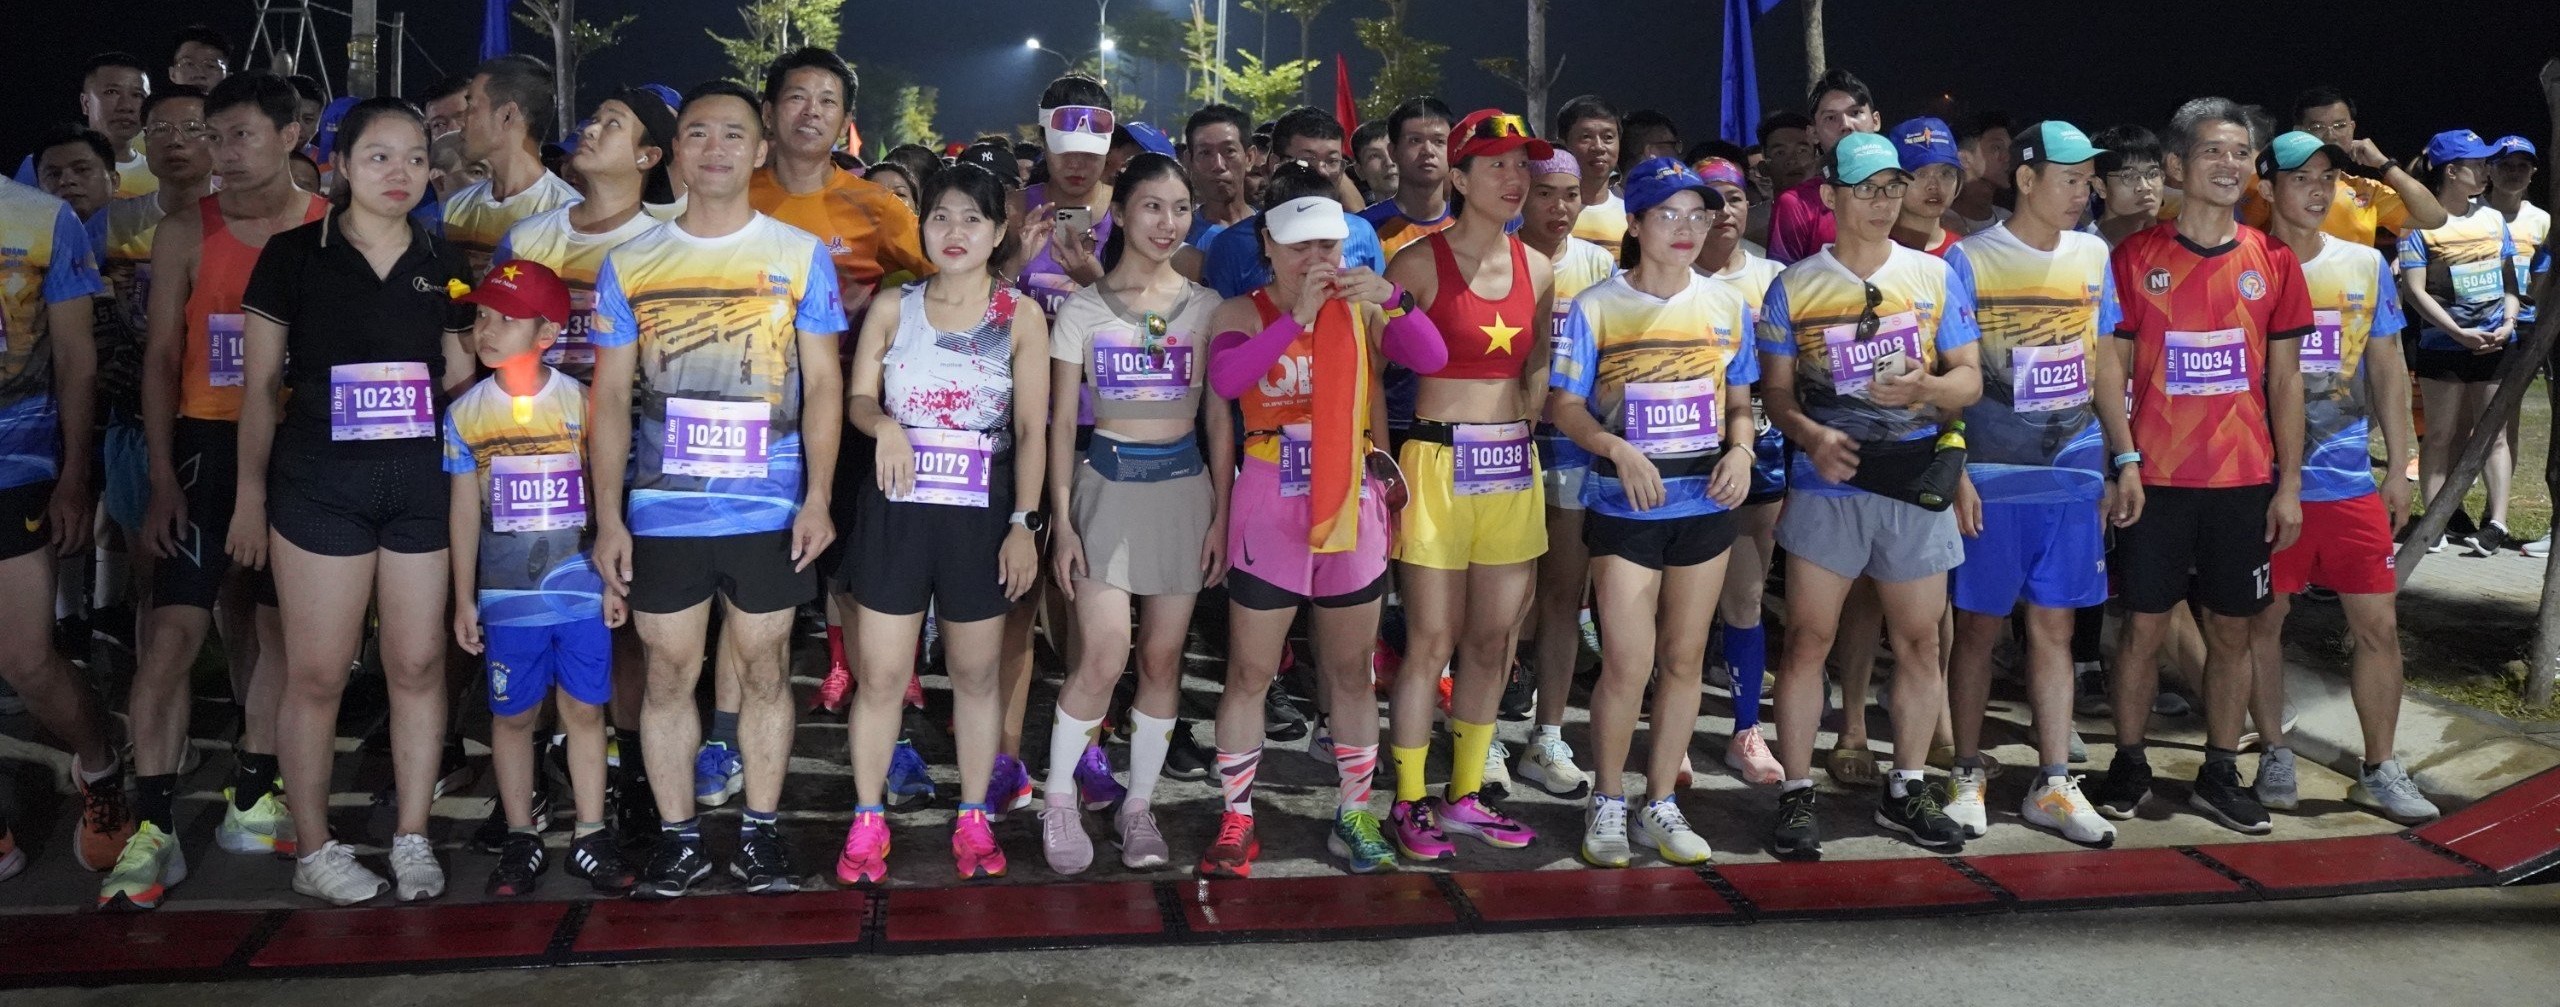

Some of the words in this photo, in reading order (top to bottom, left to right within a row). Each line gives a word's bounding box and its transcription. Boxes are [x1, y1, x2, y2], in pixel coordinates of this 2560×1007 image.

[2151, 272, 2171, 288] NT
[2462, 271, 2497, 288] 50489
[211, 335, 219, 347] km
[212, 349, 220, 357] 10
[1097, 351, 1104, 364] km
[1831, 347, 1840, 359] km
[2168, 349, 2175, 361] km
[2182, 349, 2233, 370] 10034
[1097, 364, 1104, 373] 10
[1113, 352, 1175, 373] 1004
[1832, 360, 1840, 368] 10
[2168, 361, 2175, 369] 10
[2031, 362, 2079, 385] 10223
[334, 386, 342, 400] km
[353, 386, 417, 409] 10239
[334, 401, 342, 410] 10
[1627, 403, 1635, 416] km
[1645, 402, 1701, 425] 10104
[668, 419, 676, 433] km
[1628, 417, 1635, 425] 10
[667, 435, 676, 443] 10
[687, 424, 747, 447] 10210
[1282, 445, 1289, 459] km
[1456, 445, 1463, 458] km
[1471, 444, 1523, 467] 10038
[915, 451, 970, 475] 10179
[1282, 459, 1289, 468] 10
[493, 477, 501, 491] km
[510, 477, 569, 501] 10182
[493, 492, 501, 501] 10
